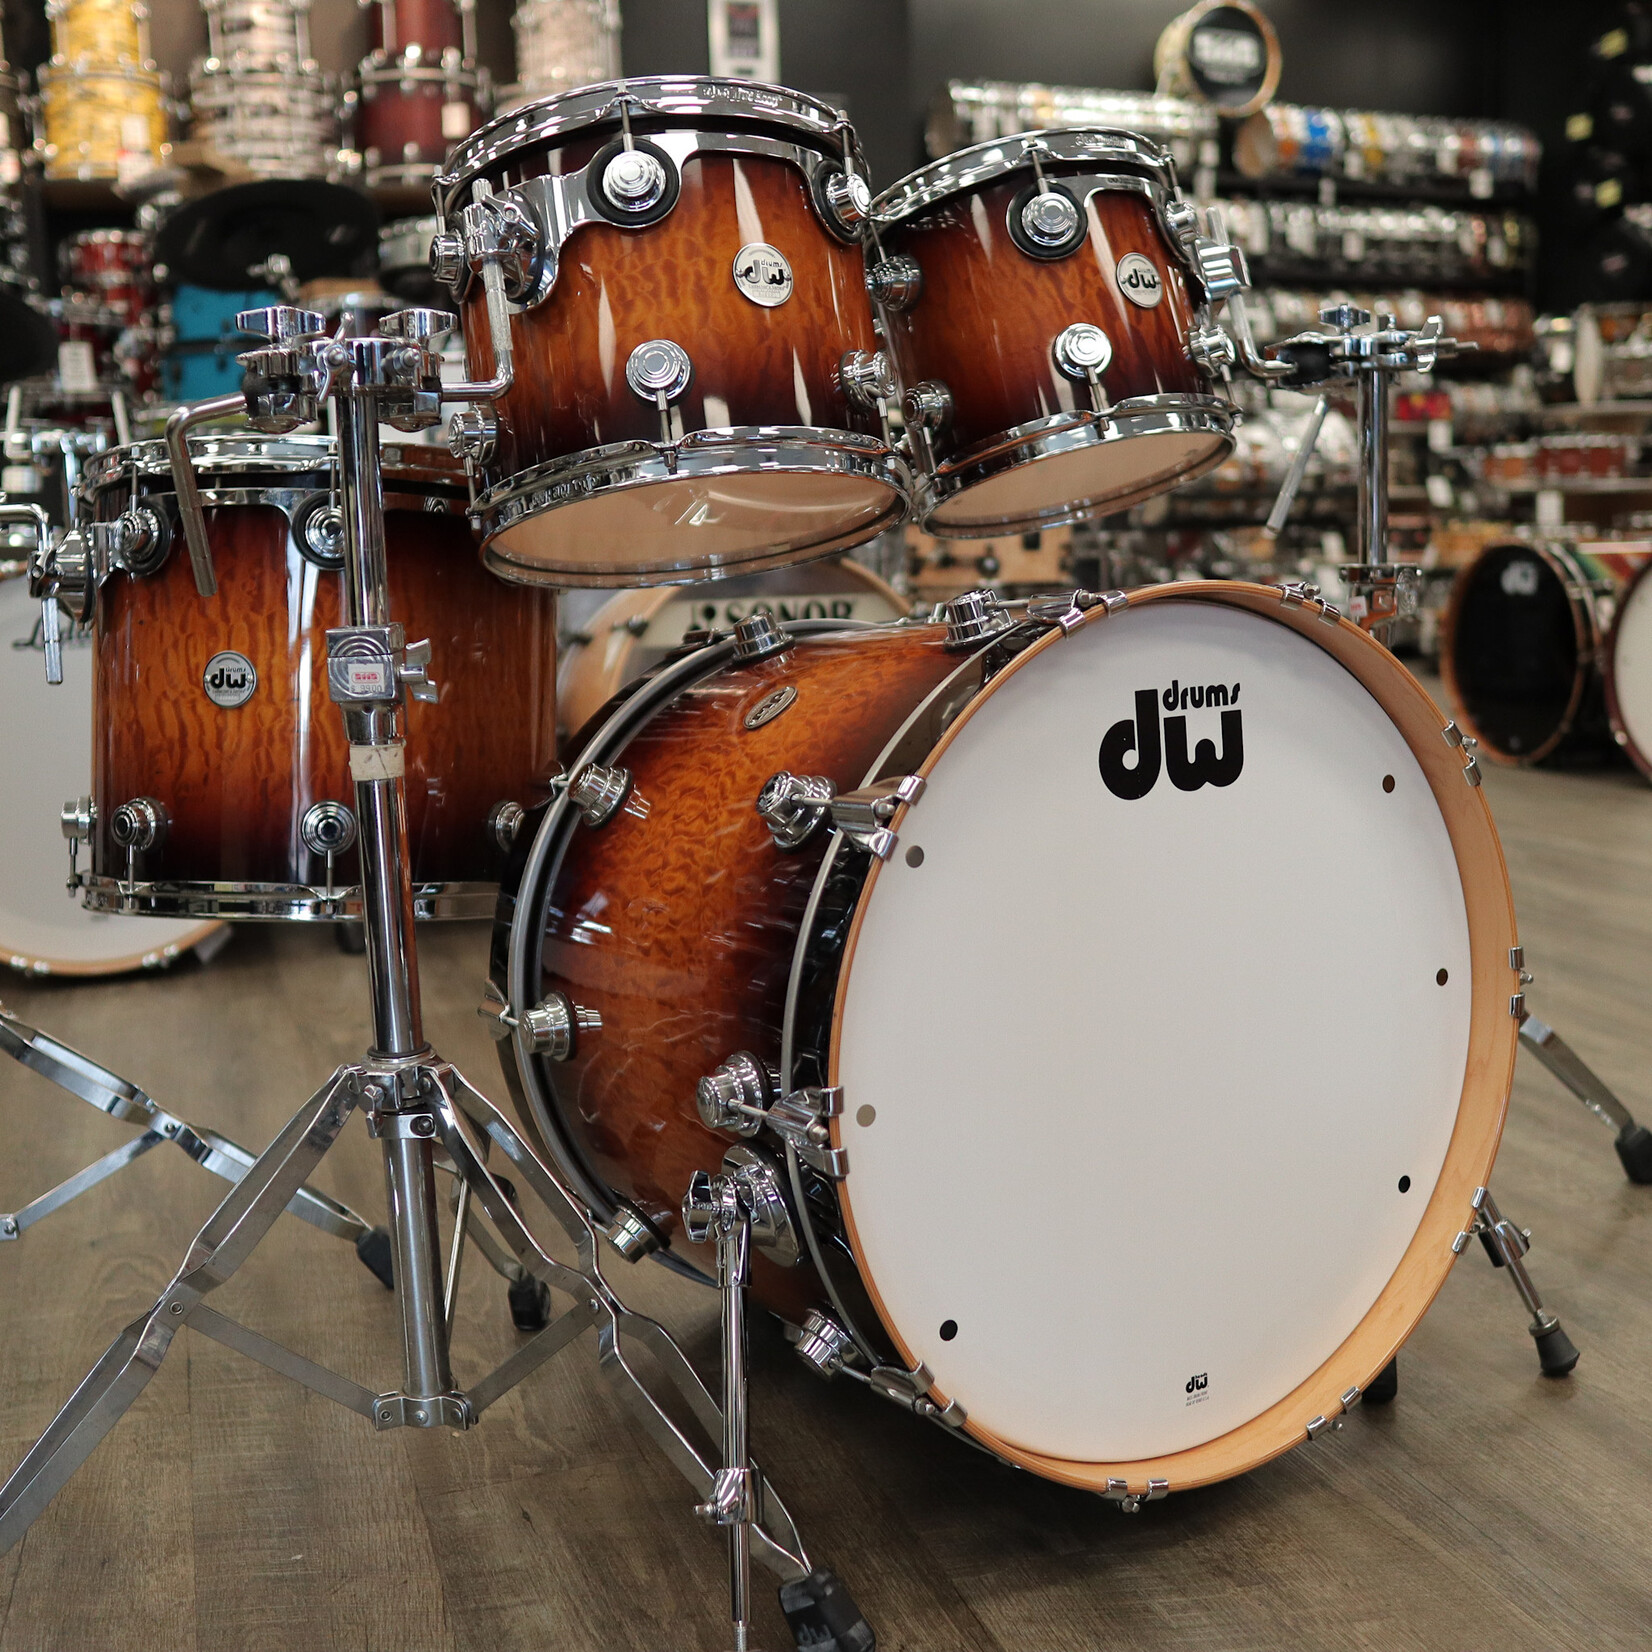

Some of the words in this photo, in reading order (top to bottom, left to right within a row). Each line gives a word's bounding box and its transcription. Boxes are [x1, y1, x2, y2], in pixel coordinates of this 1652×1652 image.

[744, 259, 785, 286] dw
[1128, 268, 1156, 289] dw
[210, 667, 246, 689] dw
[1162, 679, 1241, 712] drums
[1098, 688, 1244, 801] dw
[1185, 1376, 1208, 1394] dw
